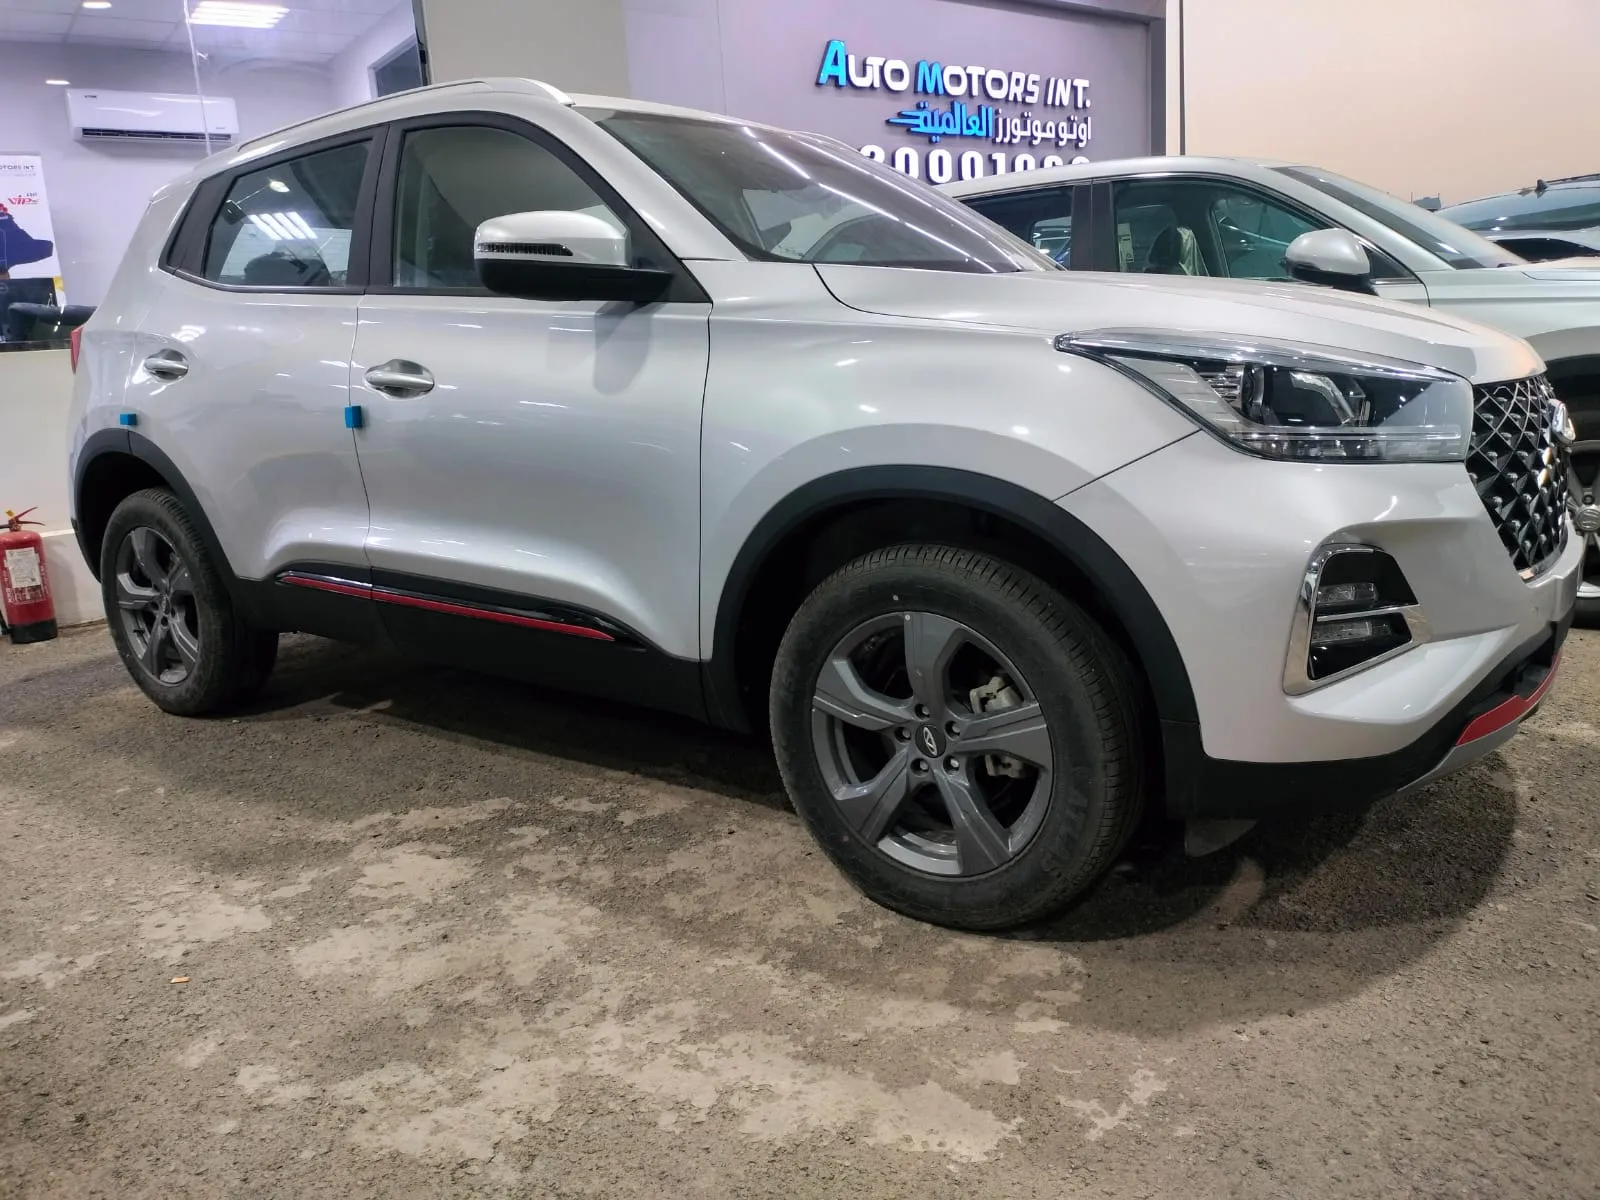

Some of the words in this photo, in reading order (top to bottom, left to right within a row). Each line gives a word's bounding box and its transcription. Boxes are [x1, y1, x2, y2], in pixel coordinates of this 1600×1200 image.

[818, 40, 910, 91] AUTO
[916, 60, 1040, 105] MOTORS
[1047, 77, 1091, 108] INT.
